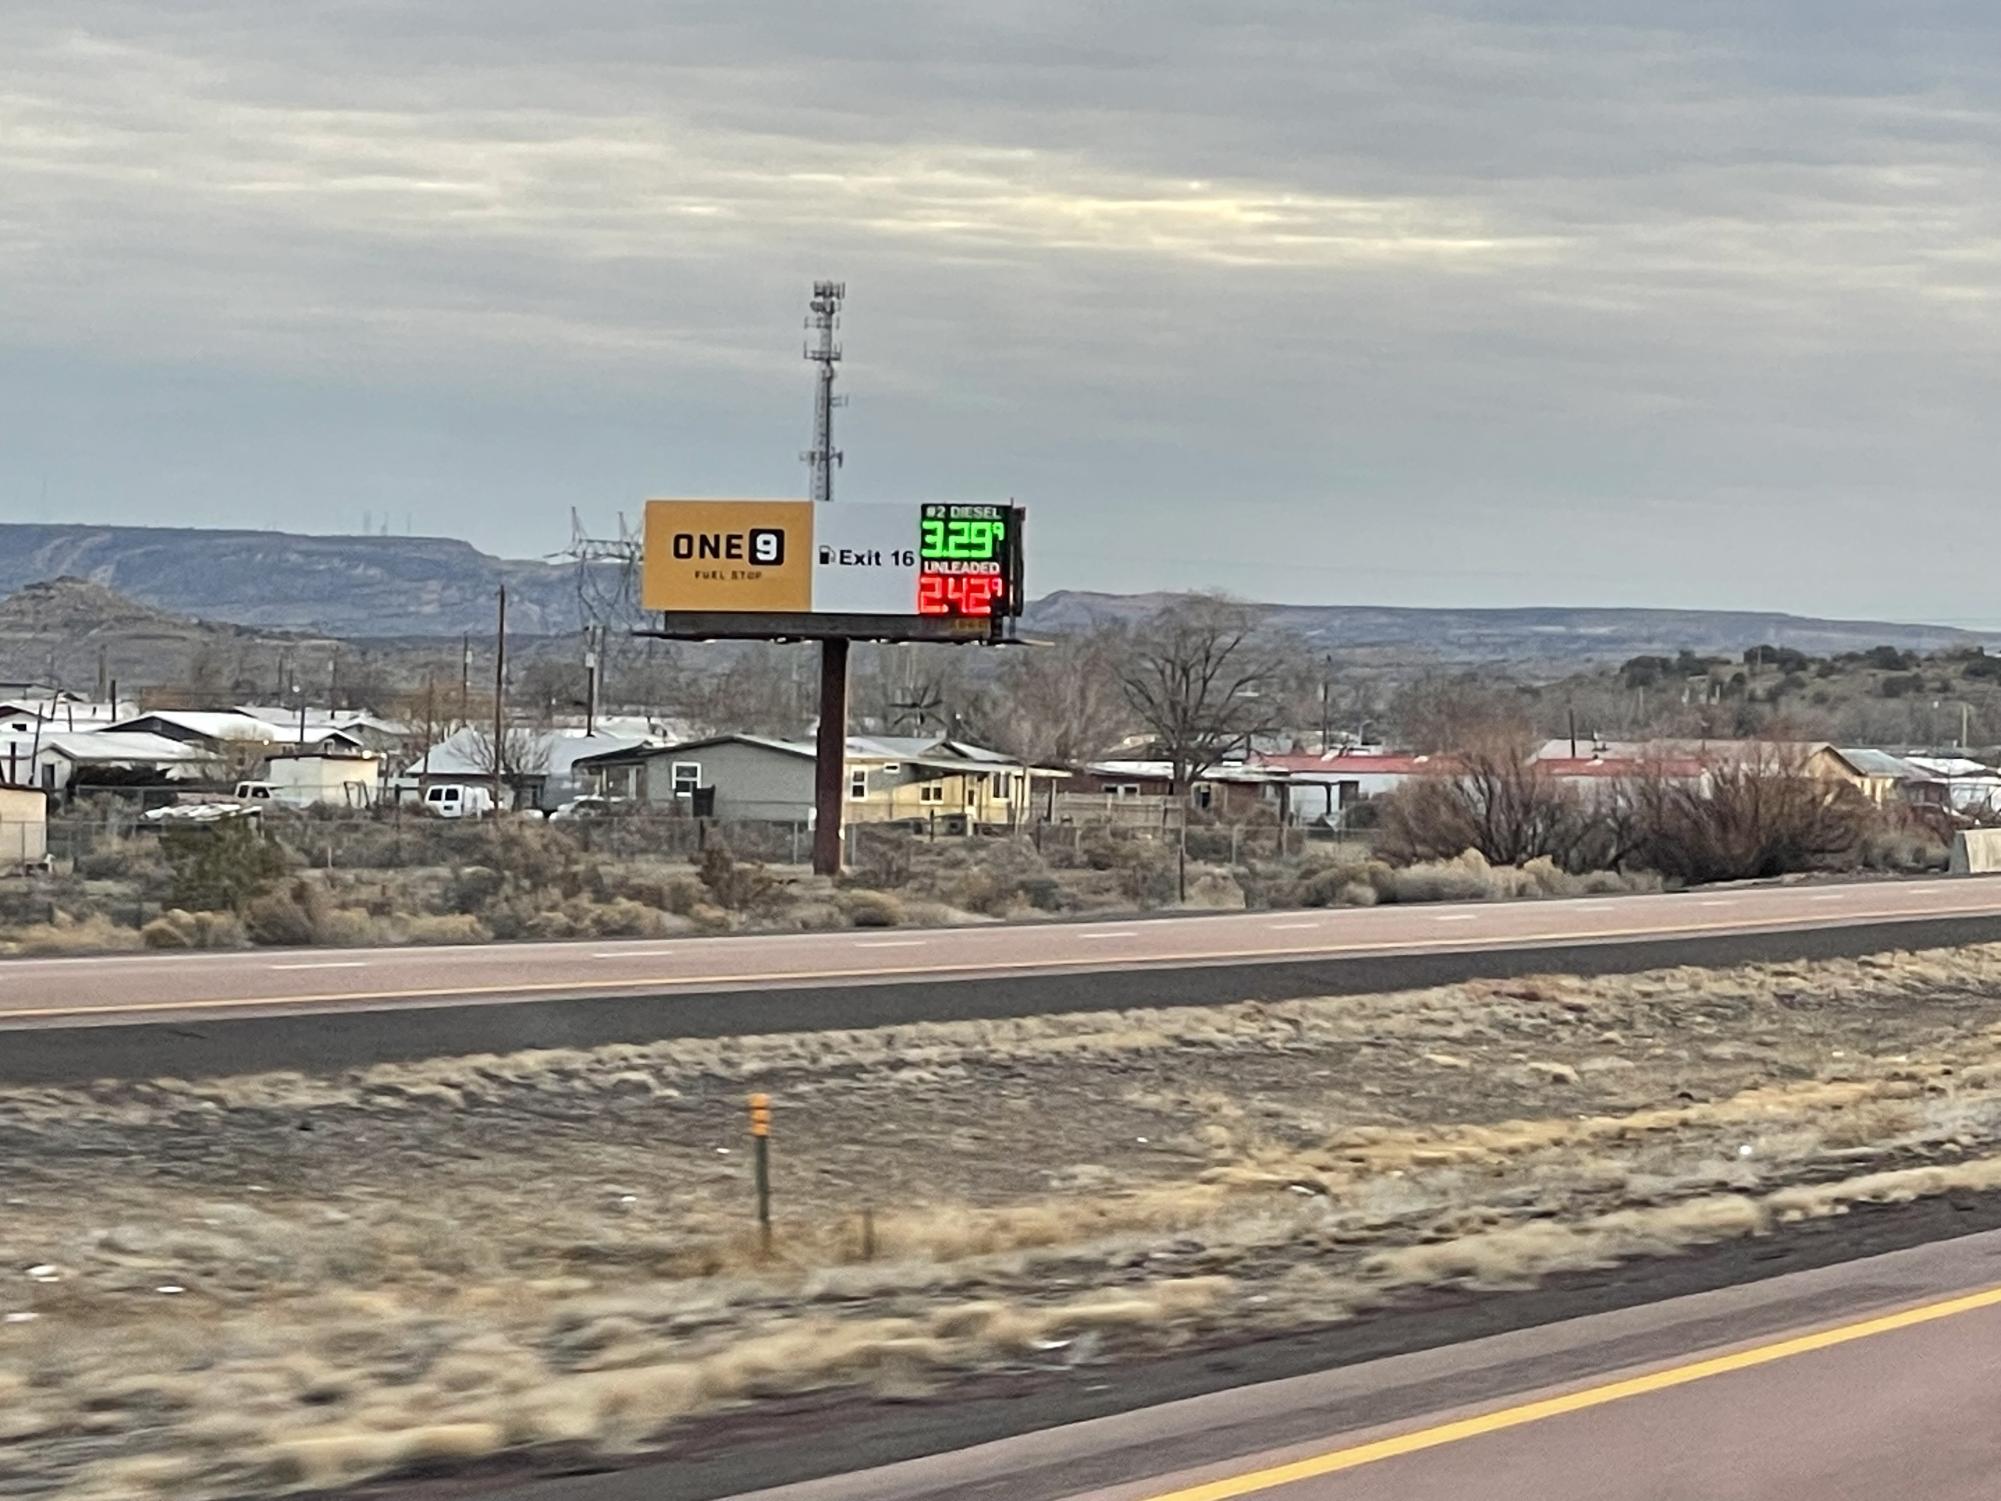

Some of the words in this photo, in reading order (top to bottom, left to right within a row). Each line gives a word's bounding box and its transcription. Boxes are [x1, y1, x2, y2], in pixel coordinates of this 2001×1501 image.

[951, 507, 1001, 519] DIESEL
[840, 549, 881, 566] Exit
[891, 550, 915, 566] 16
[924, 561, 1000, 574] UNLEADED
[695, 571, 724, 580] FUEL
[731, 571, 762, 580] STOP
